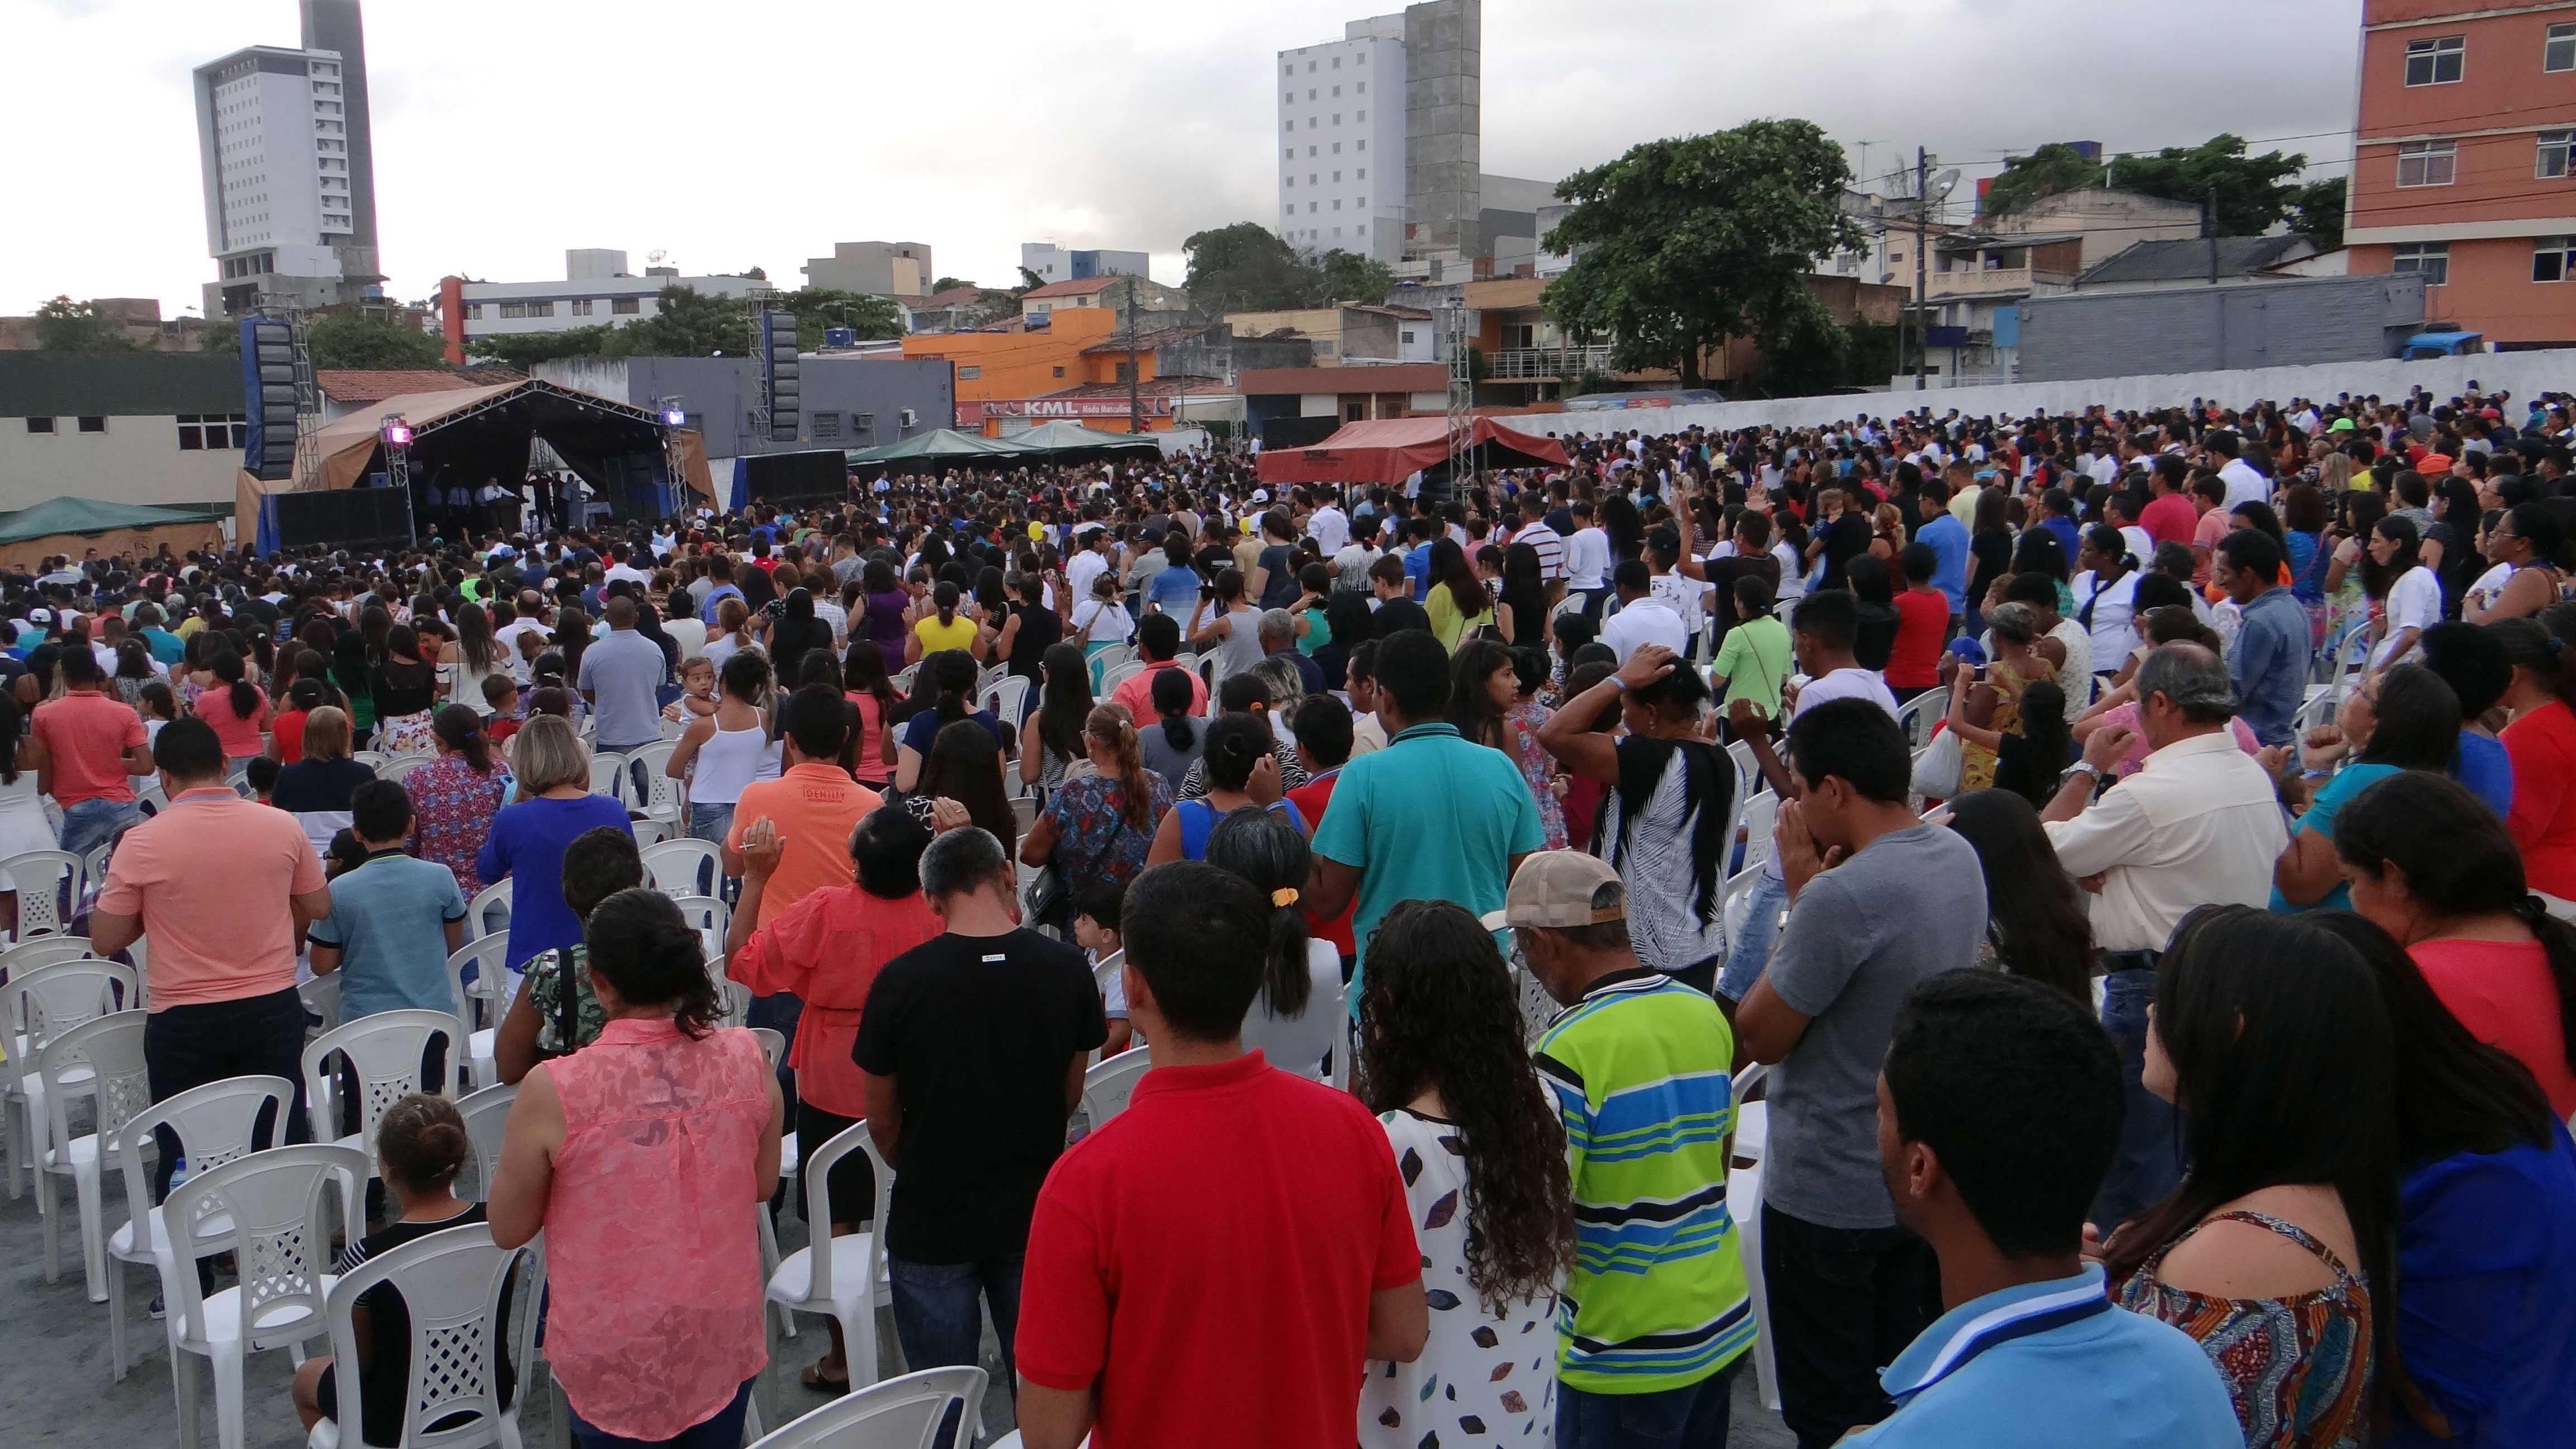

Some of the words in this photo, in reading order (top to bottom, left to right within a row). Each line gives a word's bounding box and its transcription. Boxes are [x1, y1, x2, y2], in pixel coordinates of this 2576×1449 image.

[1025, 401, 1078, 414] KML
[1082, 405, 1100, 413] Moda
[1101, 405, 1131, 413] Masculina
[803, 789, 845, 799] IDENTITY
